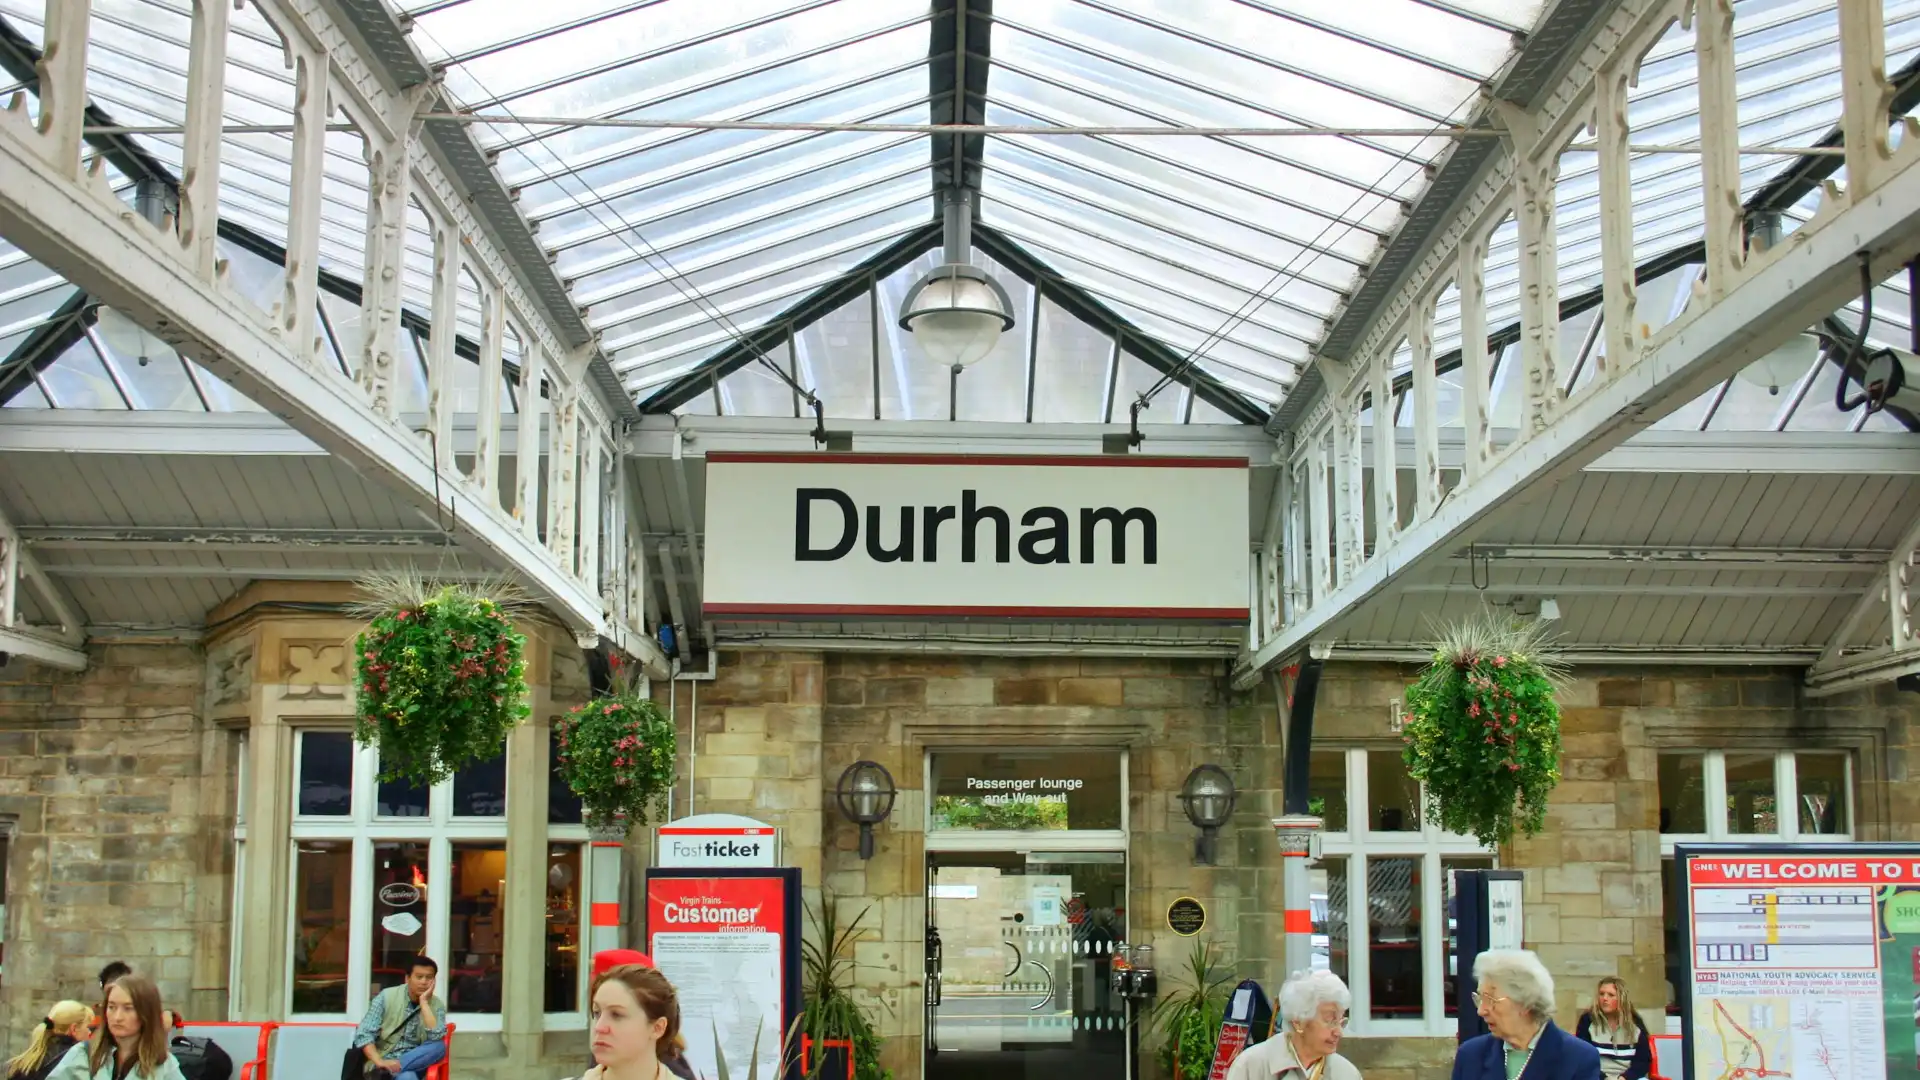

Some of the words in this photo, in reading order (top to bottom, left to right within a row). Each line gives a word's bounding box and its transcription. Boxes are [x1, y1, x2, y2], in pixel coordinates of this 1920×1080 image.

[795, 488, 1158, 565] Durham
[966, 777, 1036, 791] Passenger
[1040, 777, 1083, 791] lounge
[984, 792, 1009, 804] and
[1012, 792, 1041, 806] Way
[1047, 792, 1067, 804] out
[705, 841, 760, 857] ticket
[1721, 863, 1857, 878] WELCOME
[1866, 863, 1902, 878] TO
[680, 896, 700, 906] Virgin
[702, 896, 722, 905] Trains
[664, 903, 758, 923] Customer
[719, 924, 767, 933] information
[1697, 973, 1717, 981] NYAS
